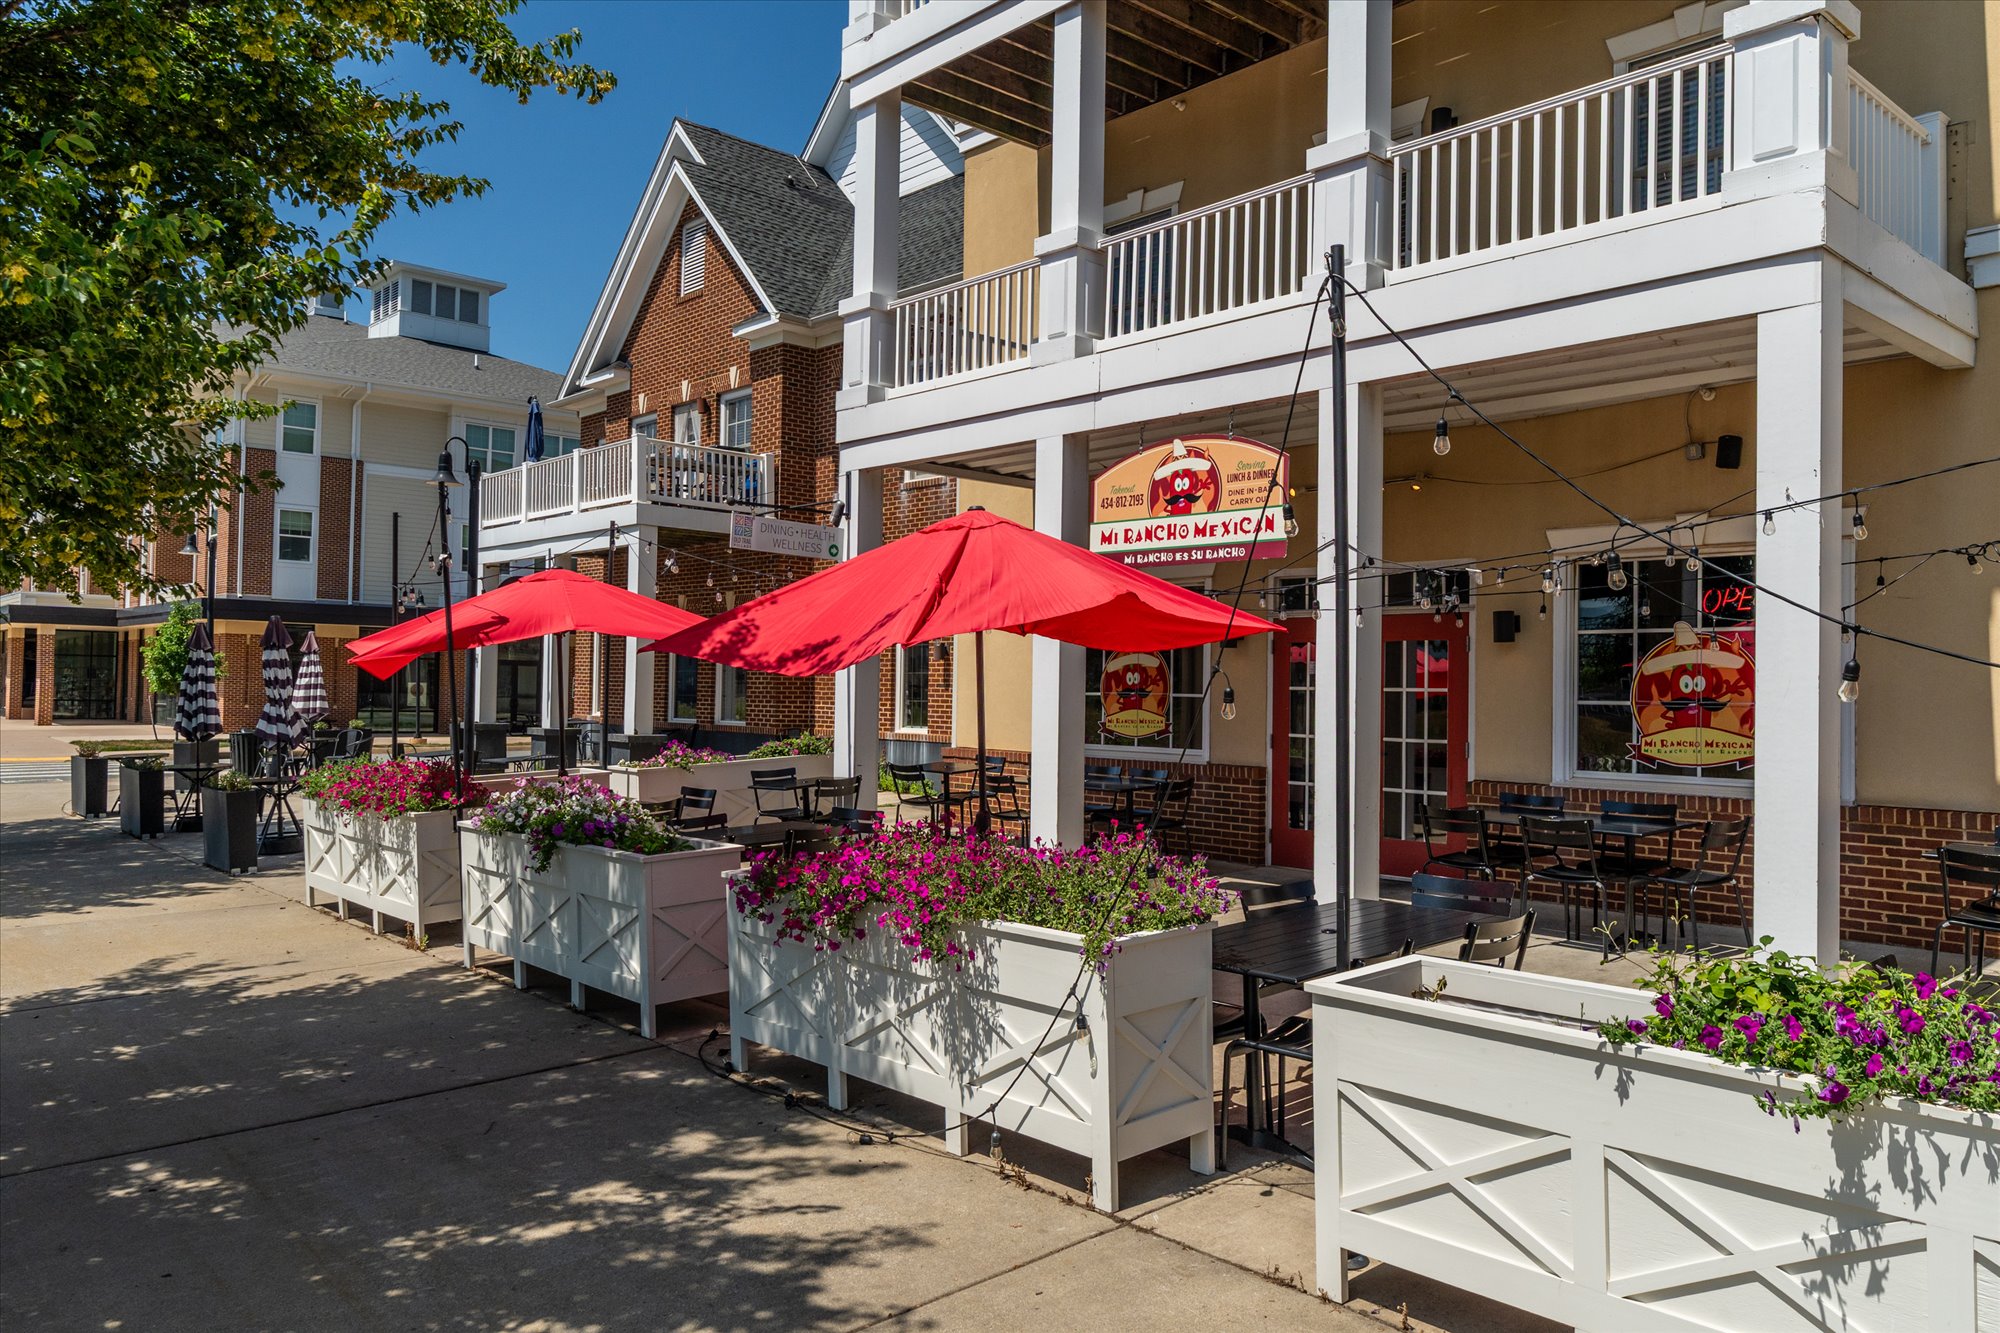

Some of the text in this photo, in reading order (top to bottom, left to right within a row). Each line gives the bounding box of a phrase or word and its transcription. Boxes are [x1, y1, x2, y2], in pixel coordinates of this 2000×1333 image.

[1236, 460, 1266, 472] Serving
[1227, 472, 1246, 483] LUNCH
[1247, 471, 1252, 481] &
[1110, 484, 1136, 495] Takeout
[1230, 498, 1254, 506] CARRY
[760, 522, 836, 542] DINING HEALTH
[1124, 524, 1189, 544] RANCHO
[1194, 513, 1275, 538] MEXICAN
[772, 538, 822, 554] WELLNESS
[1137, 552, 1174, 564] RANCHO
[1176, 552, 1189, 561] ES
[1191, 550, 1204, 560] SU
[1206, 548, 1246, 559] RANCHO
[1703, 586, 1753, 613] OPE
[1660, 739, 1701, 748] RANCHO
[1705, 739, 1752, 749] MEXICAN
